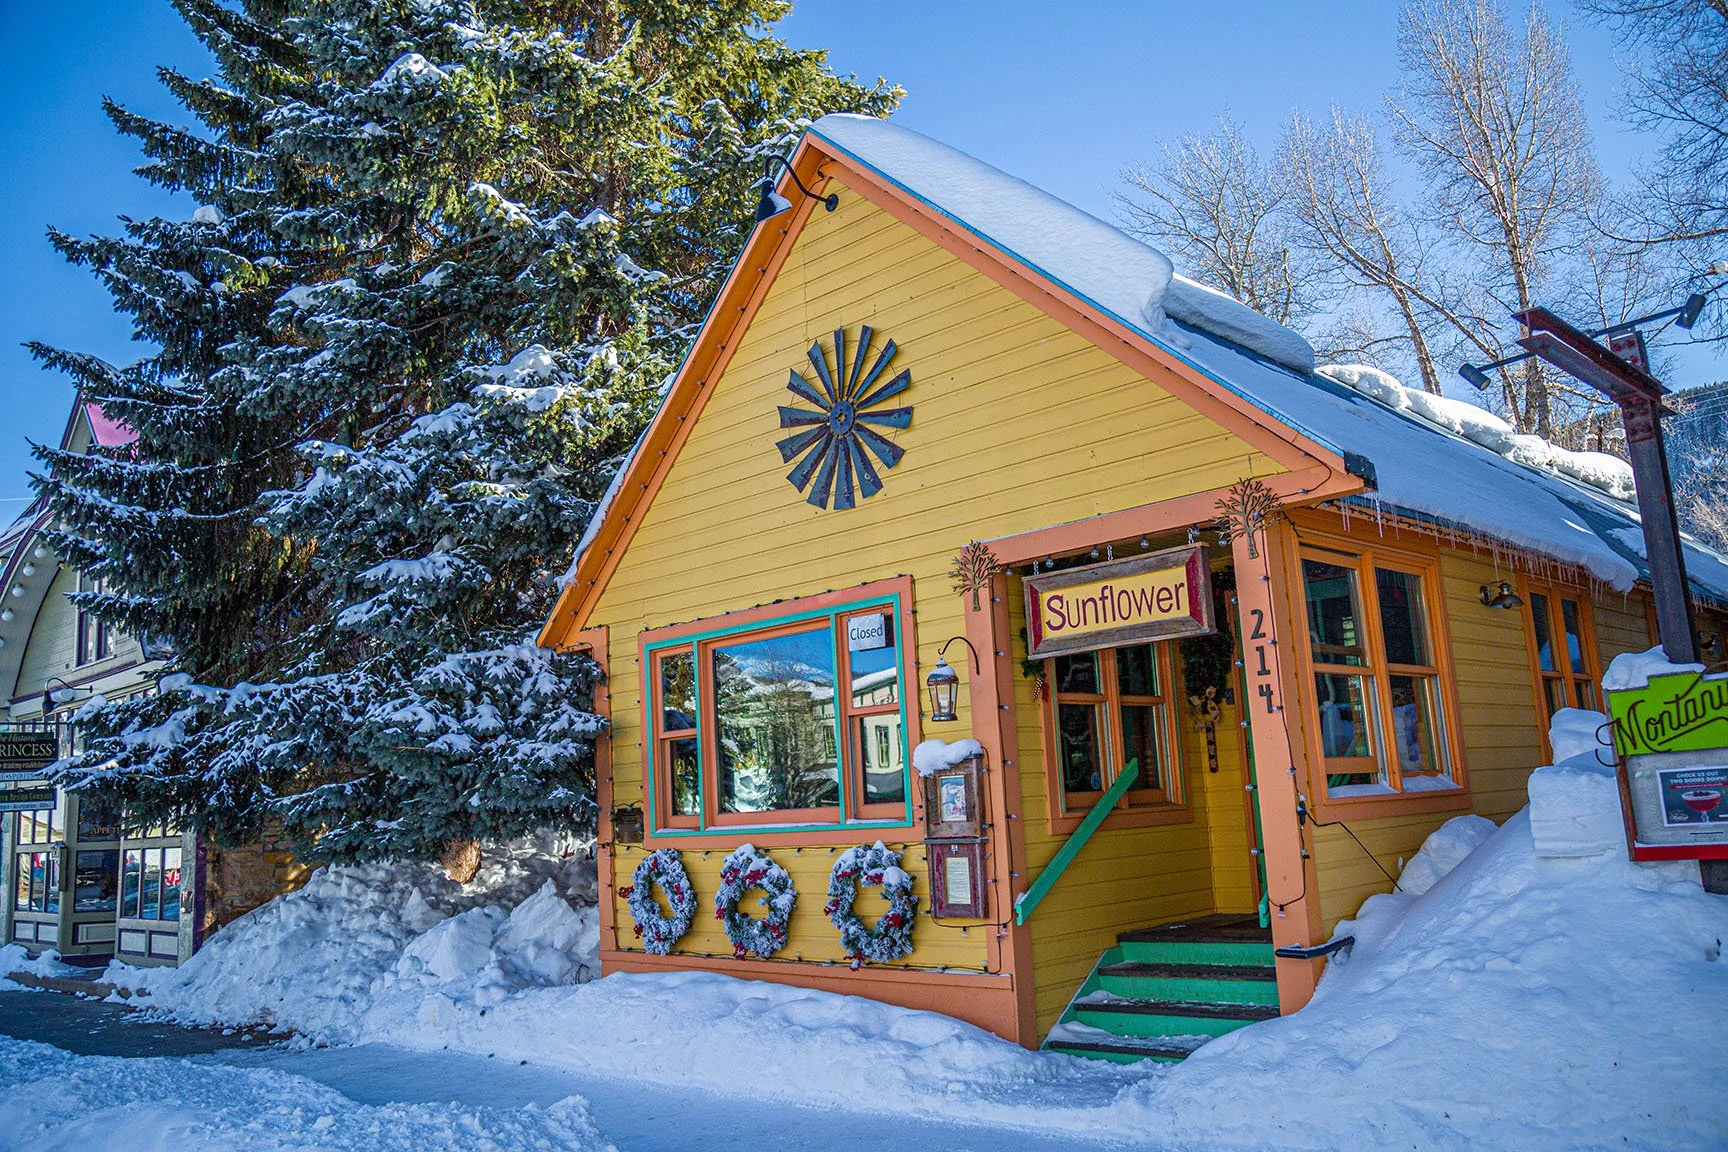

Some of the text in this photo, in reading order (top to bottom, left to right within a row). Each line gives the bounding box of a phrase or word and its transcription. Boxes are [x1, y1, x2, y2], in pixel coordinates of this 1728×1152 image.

[1045, 582, 1186, 631] Sunflower
[850, 624, 883, 641] Closed
[1250, 609, 1274, 714] 214
[8, 733, 37, 742] Historic
